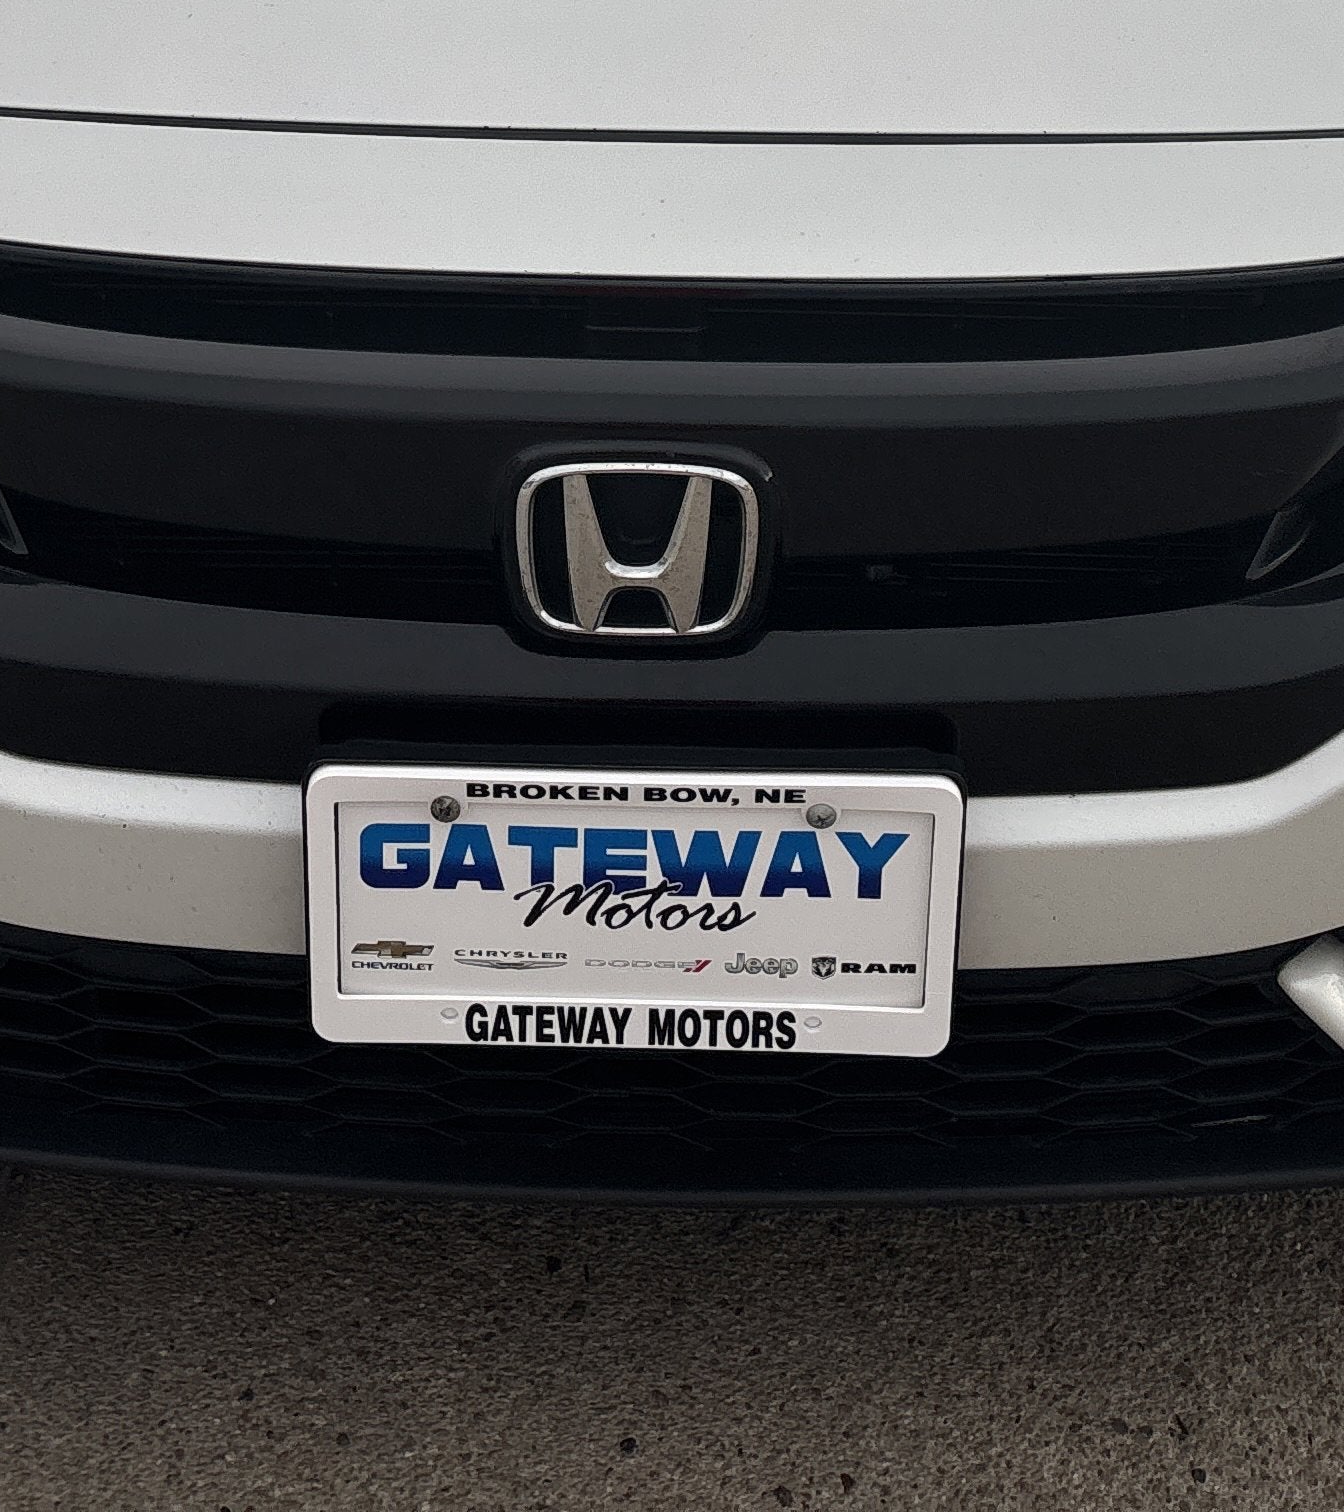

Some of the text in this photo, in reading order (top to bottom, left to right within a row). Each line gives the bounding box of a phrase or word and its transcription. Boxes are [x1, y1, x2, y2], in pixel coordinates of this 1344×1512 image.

[466, 783, 807, 806] BROKEN BOW, NE
[359, 822, 911, 899] GATEWAY
[512, 880, 757, 932] Motors
[351, 960, 434, 972] CHEVROLET
[454, 949, 568, 960] CHRYSLER
[584, 958, 696, 969] DODGE
[724, 952, 799, 979] Jeep
[841, 962, 917, 975] RAM
[464, 1003, 797, 1050] GATEWAY MOTORS
